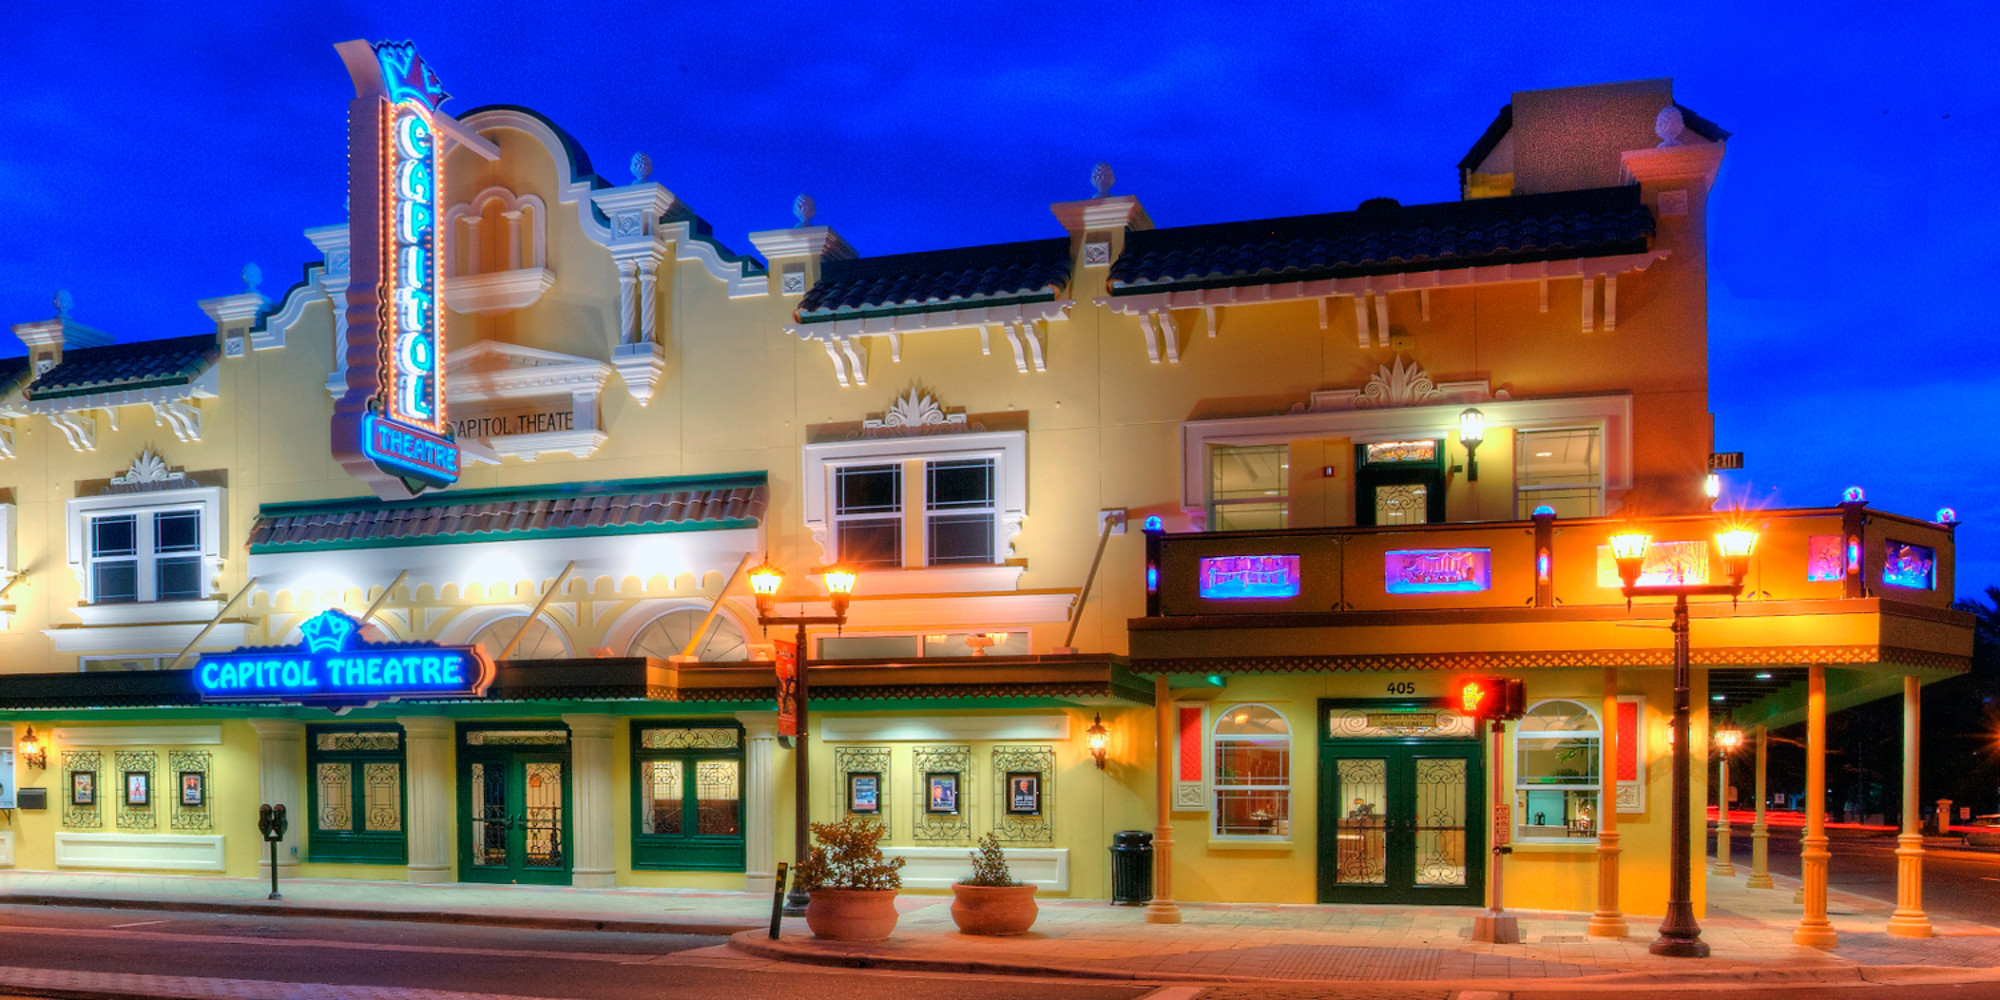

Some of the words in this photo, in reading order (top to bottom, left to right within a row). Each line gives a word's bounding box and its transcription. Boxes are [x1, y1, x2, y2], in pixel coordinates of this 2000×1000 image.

[397, 116, 430, 419] CAPITOL
[452, 417, 511, 438] APITOL
[377, 425, 458, 472] THEATRE
[1714, 453, 1737, 469] EXIT
[201, 660, 317, 689] CAPITOL
[326, 656, 462, 686] THEATRE
[1387, 682, 1415, 694] 405
